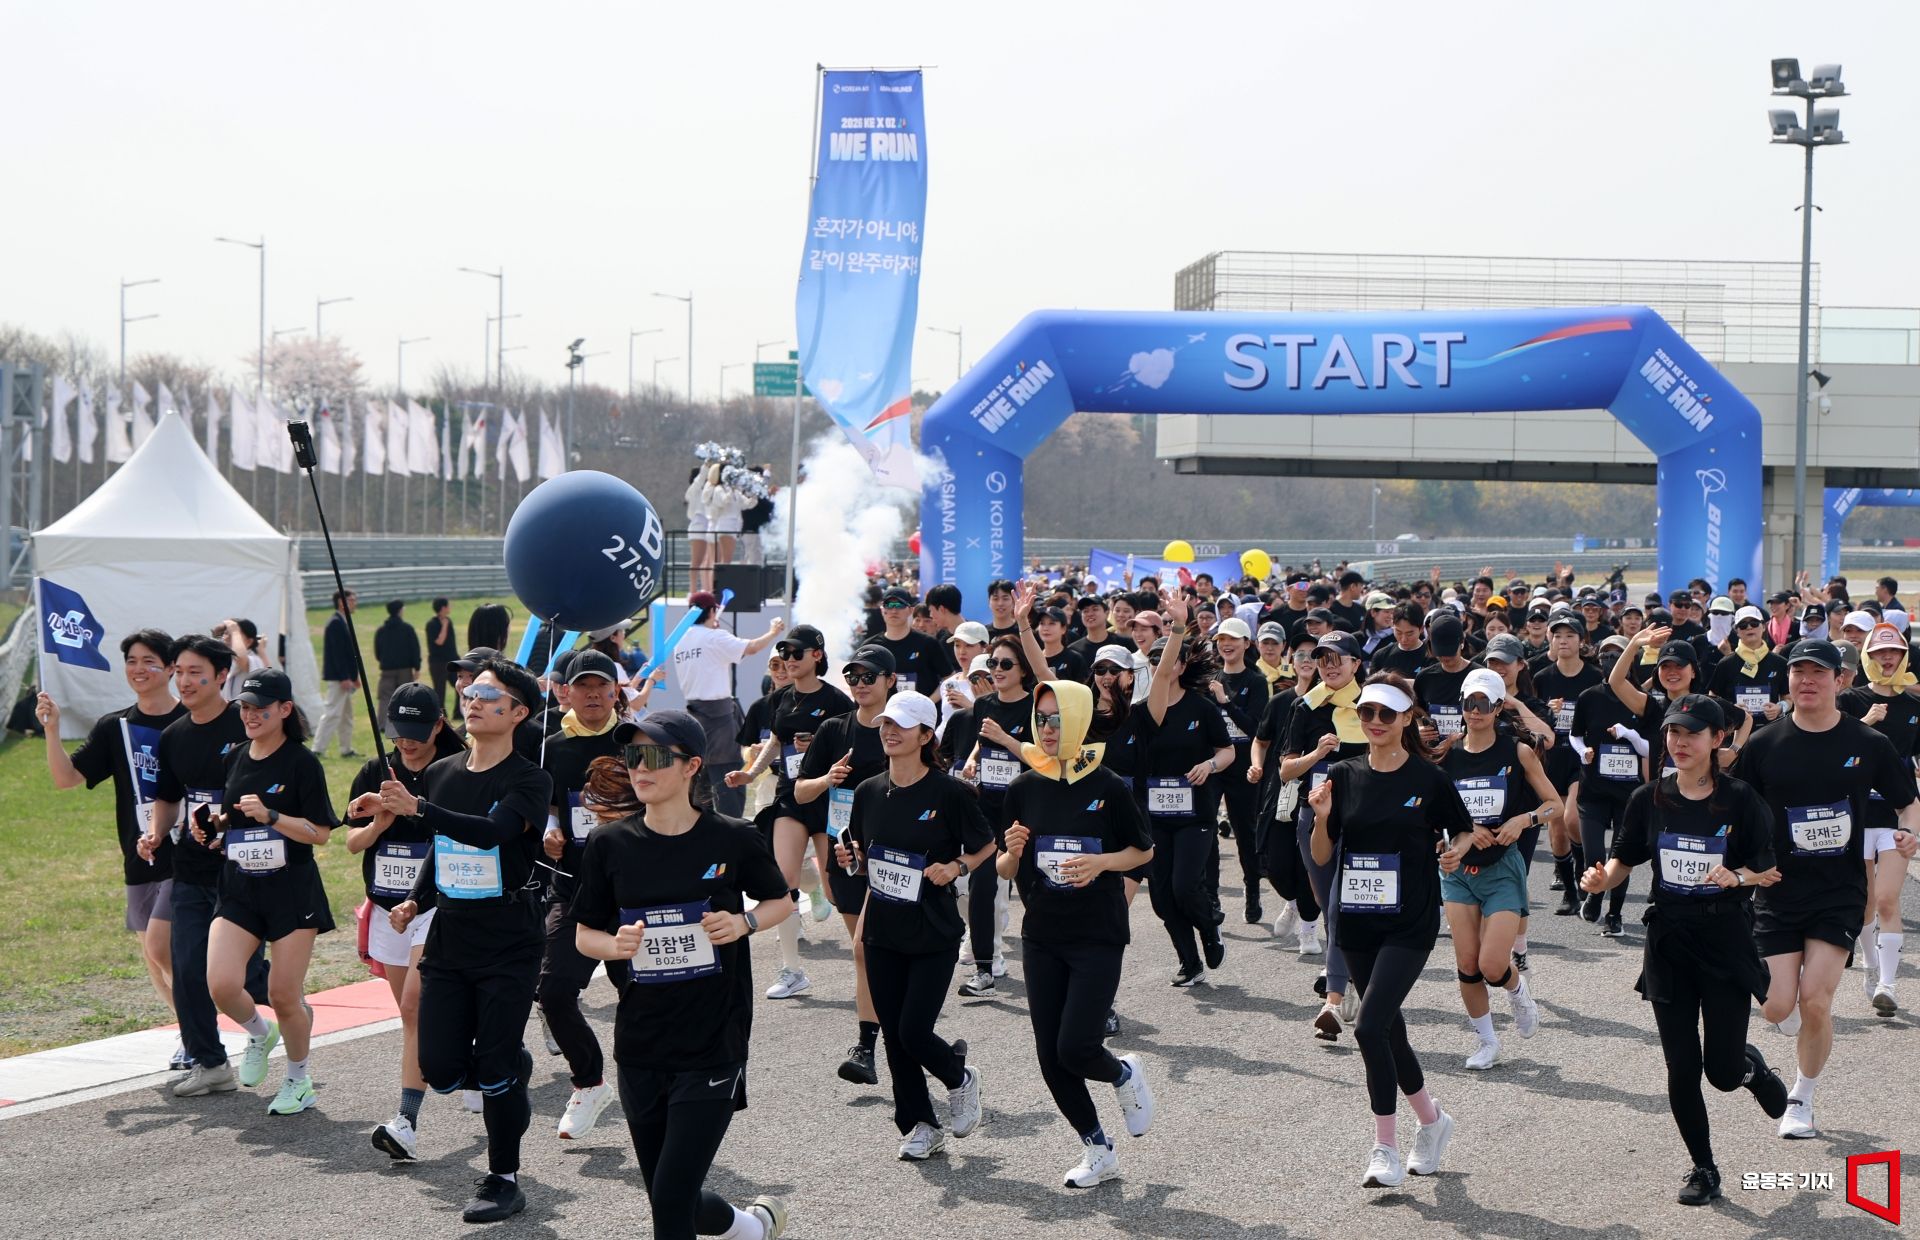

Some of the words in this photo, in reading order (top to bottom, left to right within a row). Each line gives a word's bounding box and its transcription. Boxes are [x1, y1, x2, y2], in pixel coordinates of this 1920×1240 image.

[864, 117, 876, 128] KE
[876, 117, 884, 128] X
[830, 132, 867, 161] WE
[870, 132, 918, 162] RUN
[813, 216, 864, 240] 혼자가
[866, 220, 918, 244] 아니야,
[810, 250, 844, 272] 같이
[1224, 331, 1466, 390] START
[1680, 374, 1689, 383] X
[978, 396, 1018, 434] WE
[1007, 360, 1055, 407] RUN
[1640, 356, 1677, 395] WE
[1667, 385, 1714, 433] RUN
[942, 470, 956, 534] ASIANA
[640, 507, 664, 560] B
[990, 500, 1004, 577] KOREAN
[1706, 502, 1722, 598] BOEIN
[601, 535, 656, 600] 27:30
[942, 539, 956, 586] AIRLI
[676, 648, 702, 664] STAFF
[134, 752, 161, 772] JUMB
[1156, 794, 1184, 803] 강경림
[1807, 812, 1818, 820] WE
[1818, 810, 1834, 818] RUN
[1804, 825, 1842, 840] 김재근
[387, 848, 398, 856] WE
[398, 849, 411, 857] RUN
[1677, 841, 1689, 849] WE
[1690, 842, 1705, 851] RUN
[238, 848, 274, 861] 이효선
[884, 852, 896, 863] WE
[896, 854, 910, 865] RUN
[382, 864, 416, 879] 김미경
[448, 862, 485, 876] 이준호
[1352, 860, 1364, 868] WE
[1364, 861, 1379, 869] RUN
[1671, 859, 1710, 874] 이성미
[876, 867, 911, 888] 박혜진
[1348, 878, 1385, 892] 모지은
[646, 914, 662, 924] WE
[663, 913, 684, 923] RUN
[644, 934, 696, 955] 김참별
[655, 956, 688, 965] B0256
